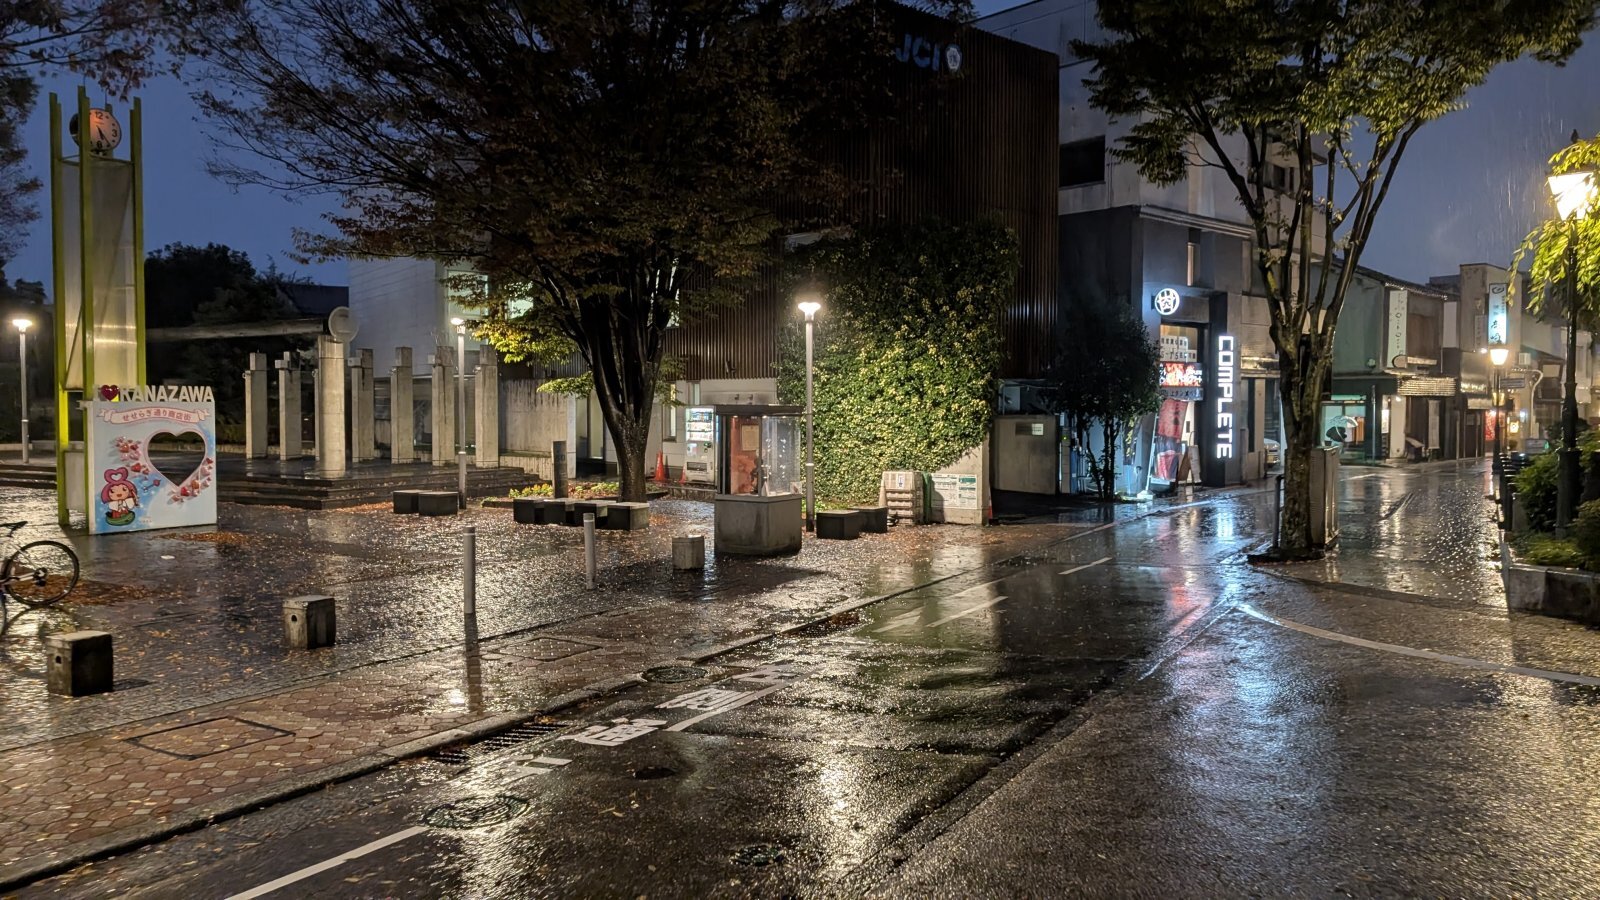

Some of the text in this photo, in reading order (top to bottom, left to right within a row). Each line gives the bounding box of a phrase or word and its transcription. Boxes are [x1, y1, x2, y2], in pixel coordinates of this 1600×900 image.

[896, 33, 941, 72] JCI
[95, 111, 103, 120] 12
[111, 129, 118, 138] 3
[96, 140, 103, 149] 6
[119, 384, 215, 403] KANAZAWA
[1217, 335, 1234, 459] COMPLETE
[122, 408, 192, 422] せせらぎ通り商店街
